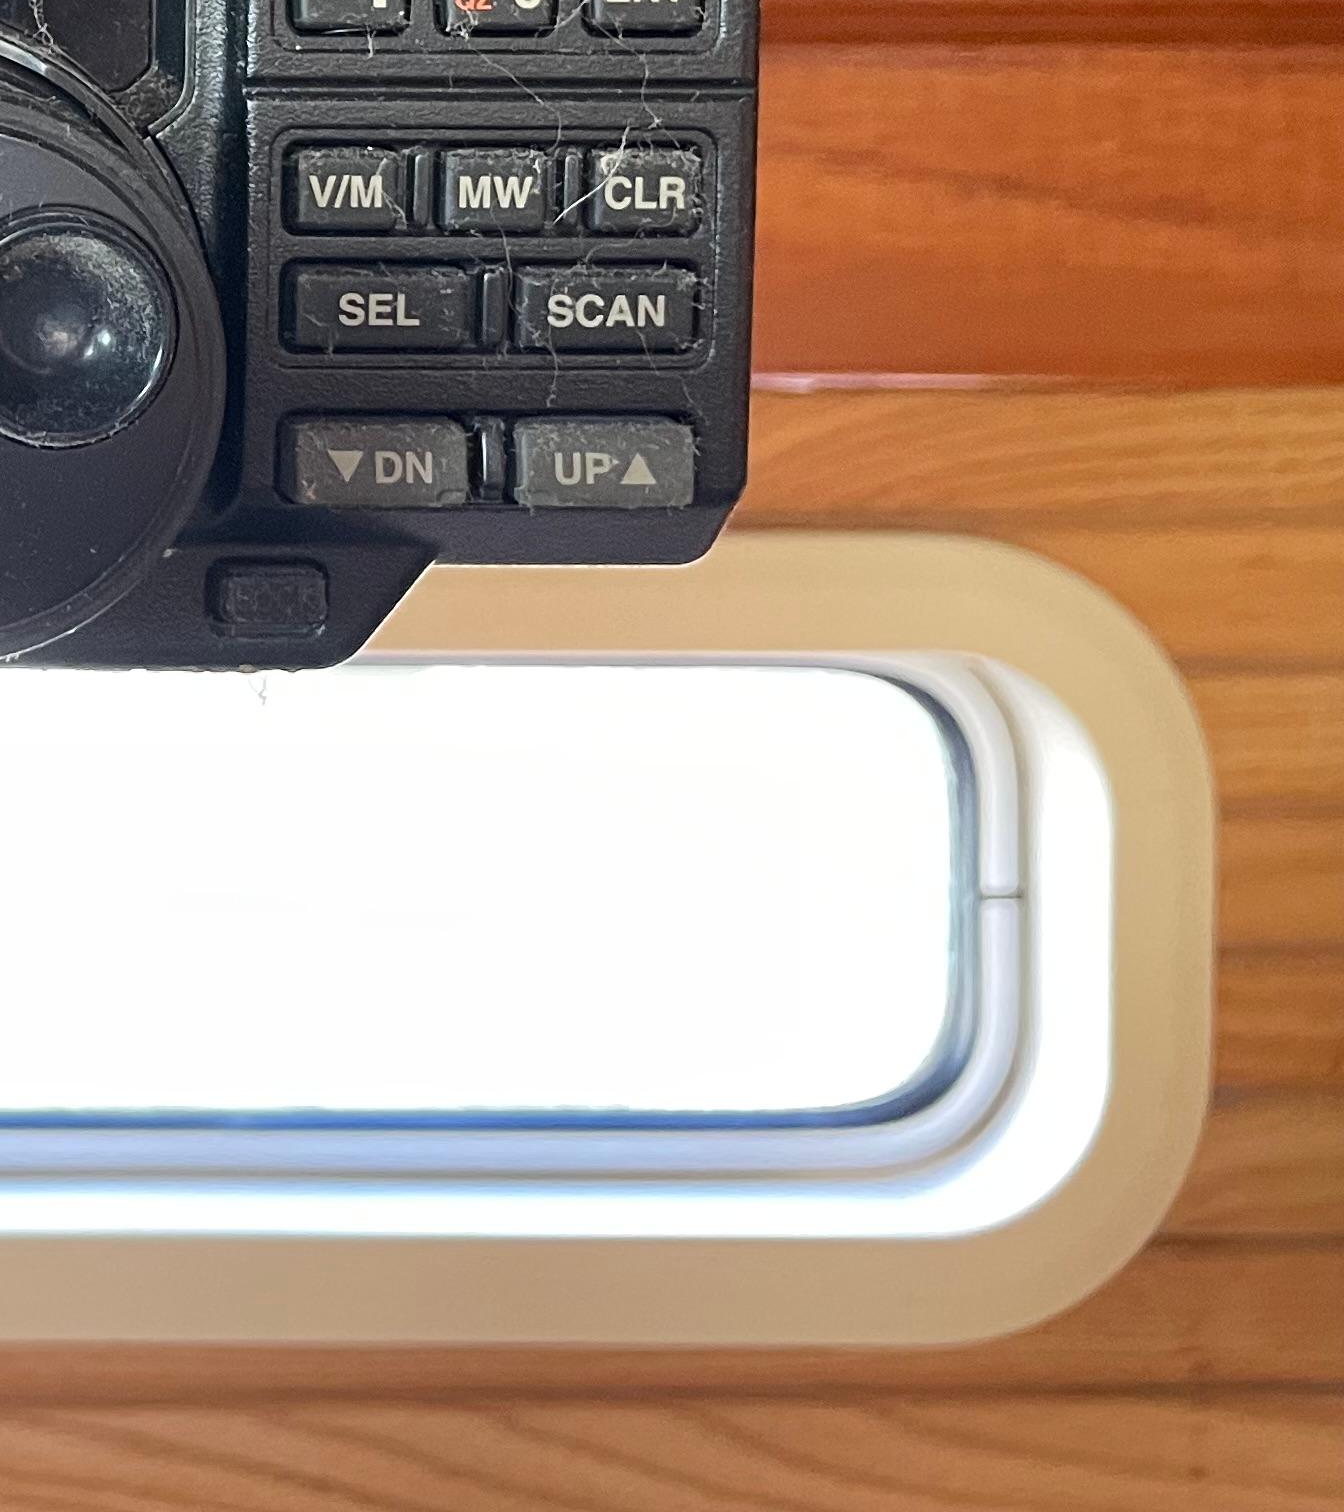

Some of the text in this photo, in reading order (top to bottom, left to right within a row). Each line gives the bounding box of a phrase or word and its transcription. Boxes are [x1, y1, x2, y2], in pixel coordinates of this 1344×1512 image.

[309, 174, 384, 209] V/M
[458, 176, 534, 210] MW
[604, 176, 686, 211] CLR
[337, 293, 421, 328] SEL
[546, 293, 666, 329] SCAN
[374, 450, 433, 485] DN
[553, 451, 611, 486] UP
